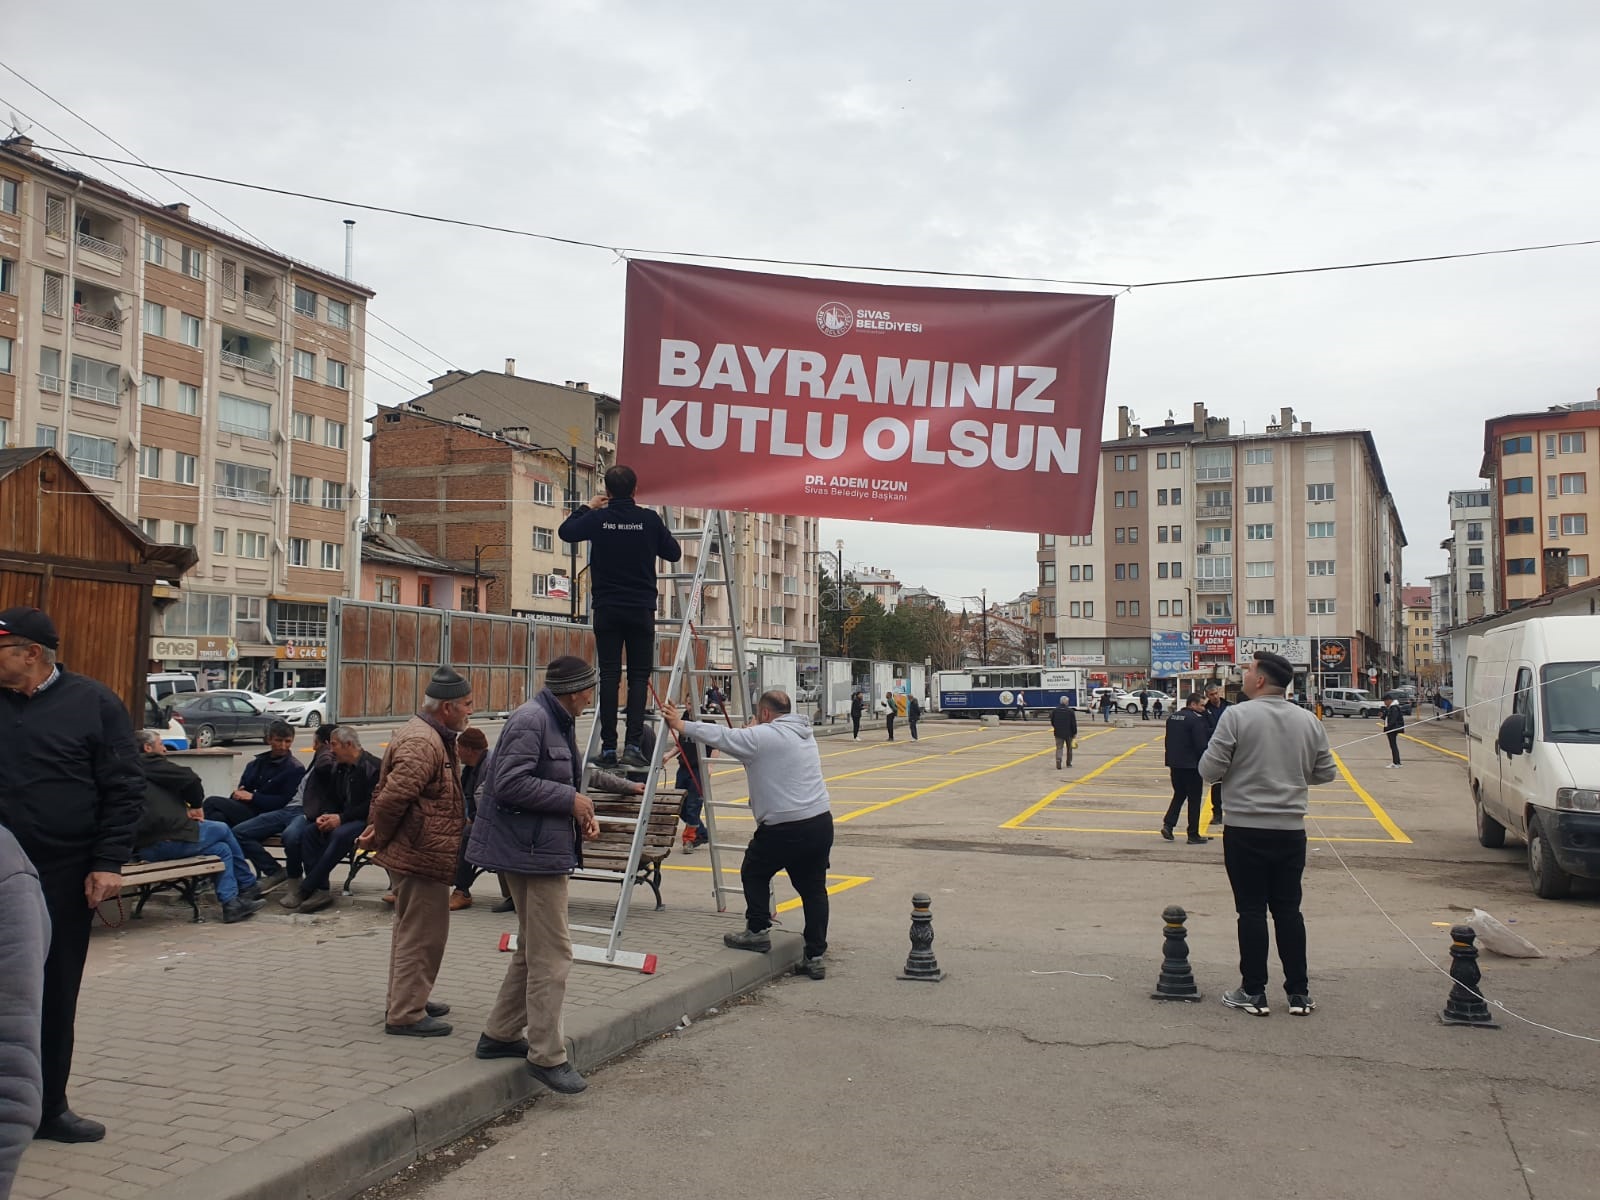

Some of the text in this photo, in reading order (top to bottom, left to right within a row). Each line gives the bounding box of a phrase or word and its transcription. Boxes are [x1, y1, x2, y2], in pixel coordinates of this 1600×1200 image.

[658, 338, 1057, 414] BAYRAMINIZ
[640, 397, 1081, 474] KUTLU OLSUN
[805, 475, 908, 492] DR. ADEM UZUN
[804, 485, 907, 502] Sivas Belediye Başkanı
[1192, 625, 1234, 638] TÜTÜNCÜ
[156, 641, 194, 656] enes
[299, 647, 318, 659] ÇAĞ
